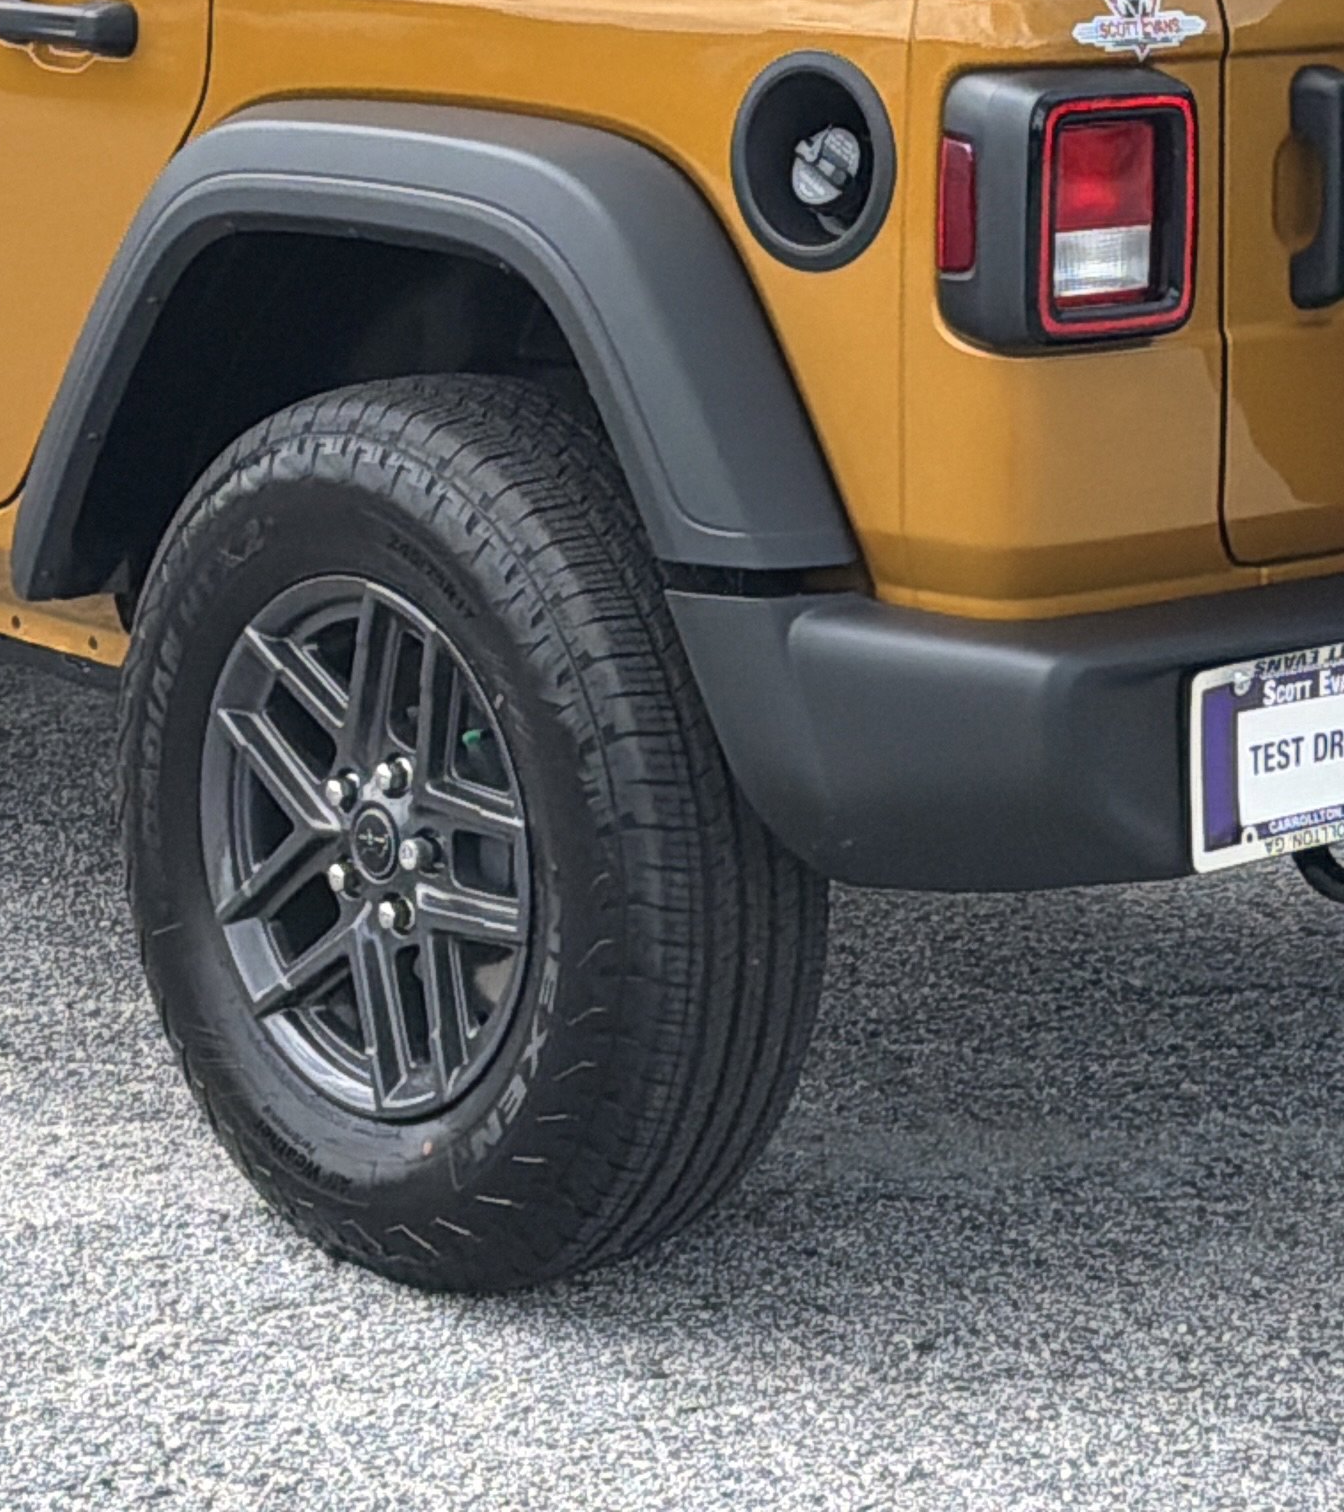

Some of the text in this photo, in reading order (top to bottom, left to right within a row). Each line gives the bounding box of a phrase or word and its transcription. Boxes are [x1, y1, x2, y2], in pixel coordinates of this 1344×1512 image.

[1099, 19, 1139, 39] SCOTT
[1255, 648, 1319, 673] EVANS
[1249, 737, 1304, 775] TEST
[1264, 838, 1286, 855] GA
